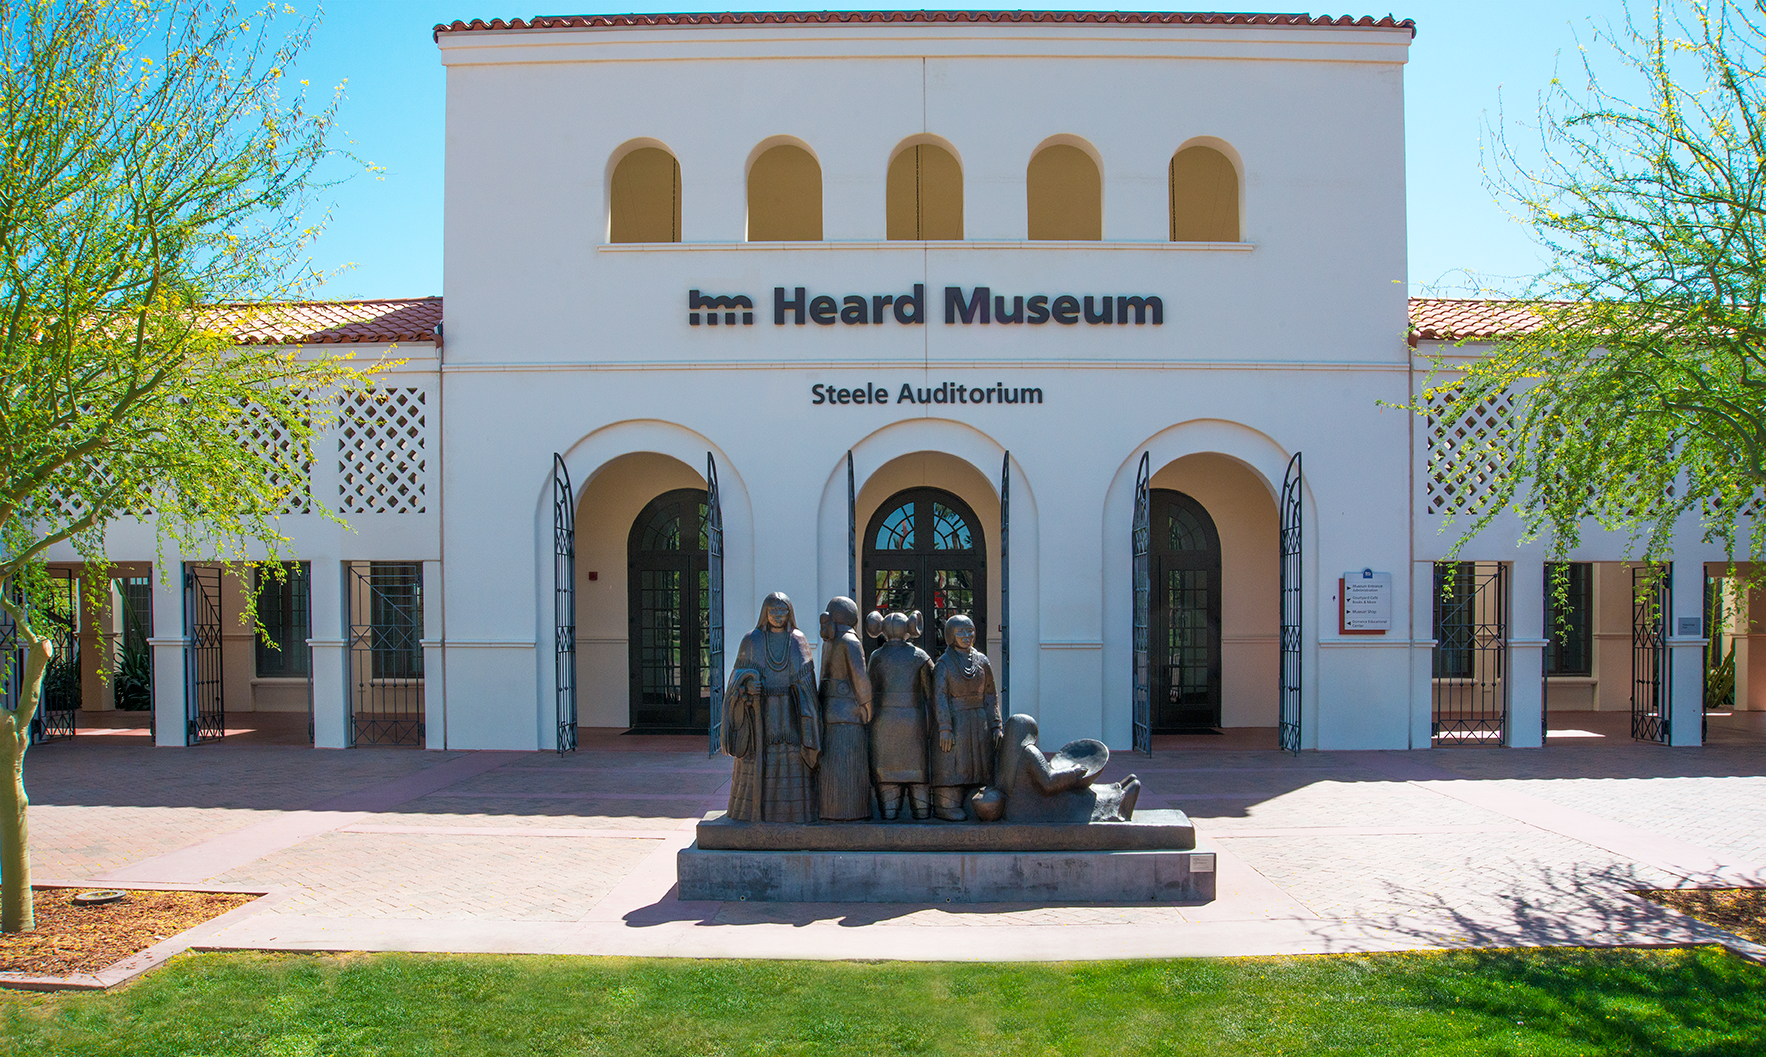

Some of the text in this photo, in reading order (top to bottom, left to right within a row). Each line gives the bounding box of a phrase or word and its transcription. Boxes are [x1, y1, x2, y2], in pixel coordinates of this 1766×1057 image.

[774, 284, 925, 325] Heard
[944, 287, 1164, 325] Museum
[811, 382, 1044, 404] Steele Auditorium
